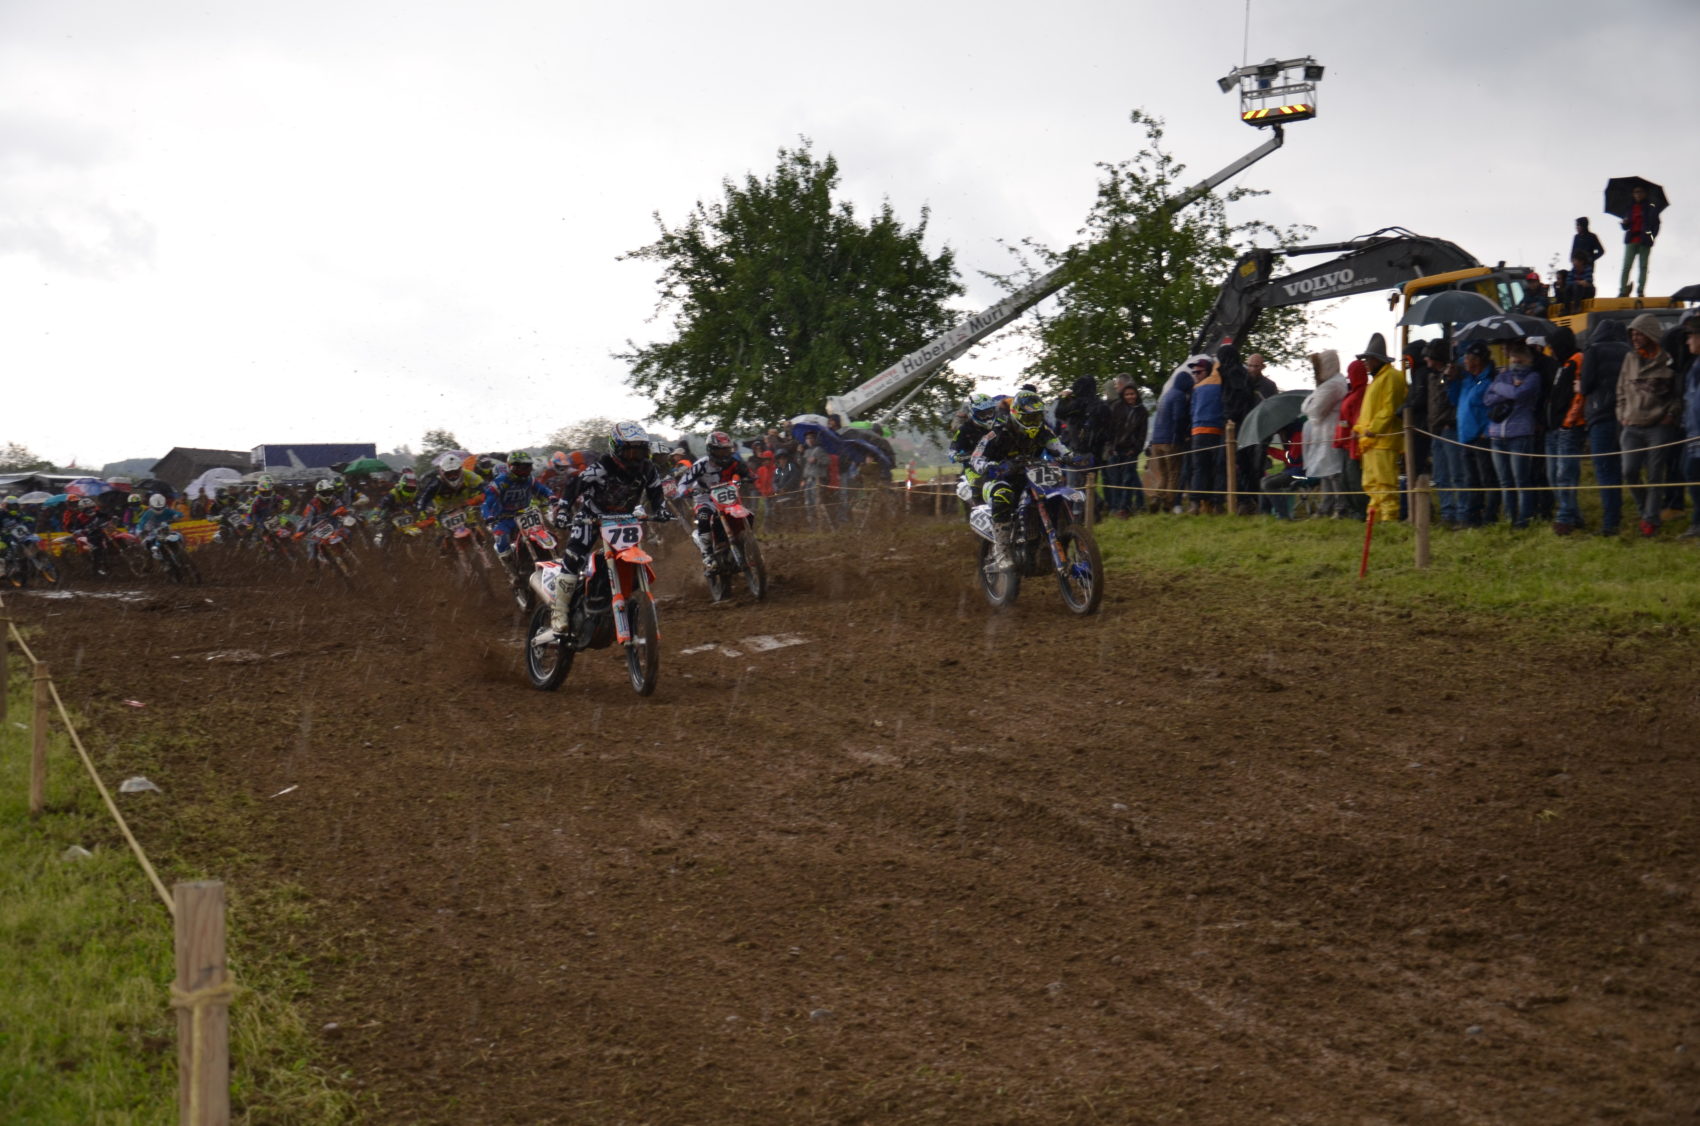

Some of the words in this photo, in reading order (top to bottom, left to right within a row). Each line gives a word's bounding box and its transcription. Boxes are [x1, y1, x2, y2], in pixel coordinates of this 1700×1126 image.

[1283, 269, 1354, 296] VOLVO
[902, 341, 947, 373] Huber
[608, 527, 639, 545] 78
